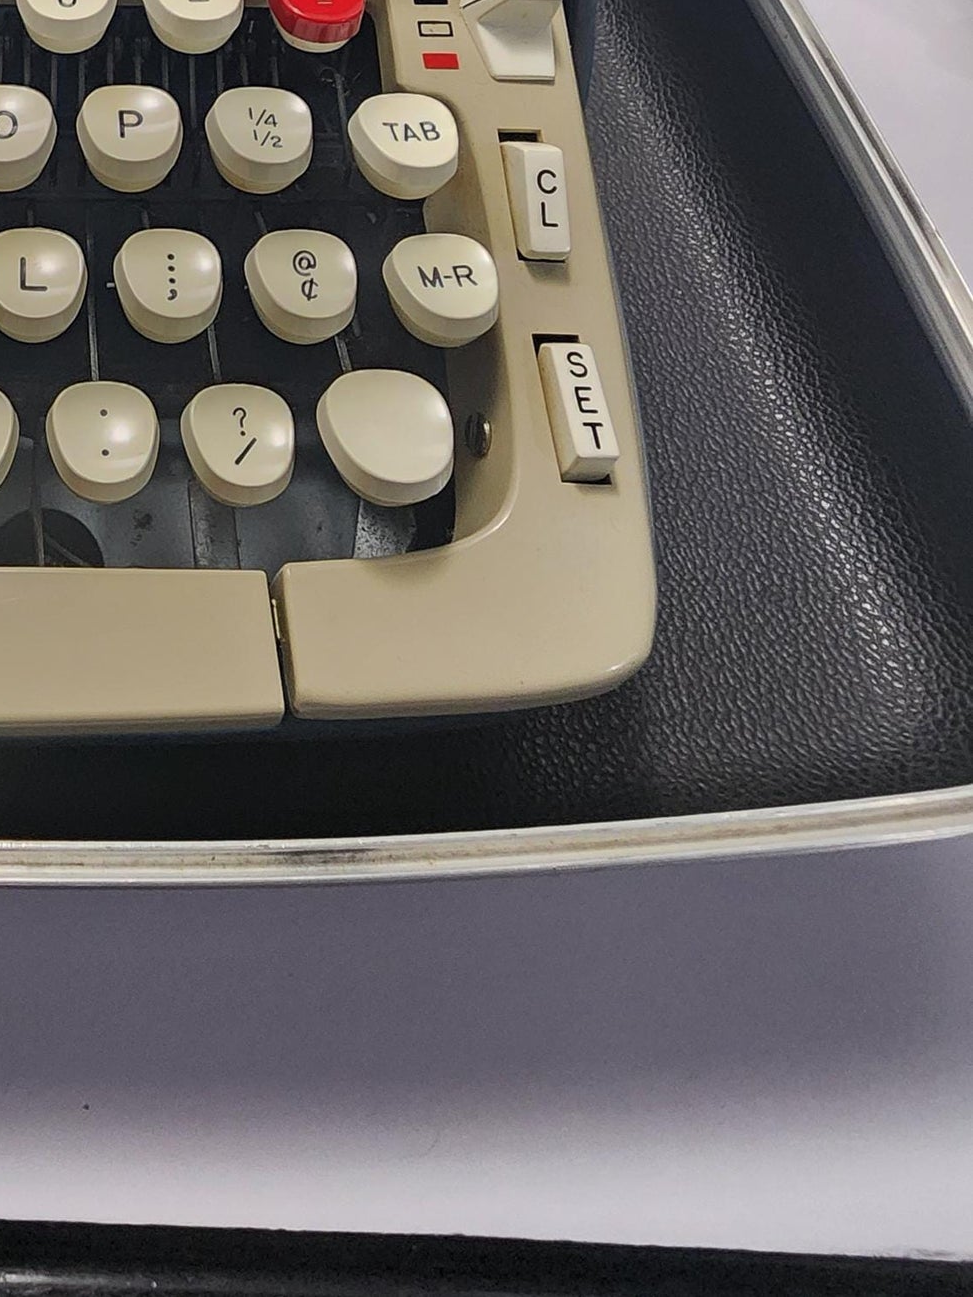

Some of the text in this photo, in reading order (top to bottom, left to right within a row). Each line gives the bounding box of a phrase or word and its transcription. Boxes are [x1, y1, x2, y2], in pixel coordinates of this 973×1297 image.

[118, 109, 144, 139] P
[382, 121, 441, 142] TAB
[536, 169, 559, 228] CL
[19, 256, 48, 292] L
[292, 249, 317, 277] @
[417, 264, 478, 288] M-R
[566, 351, 604, 450] SET
[232, 407, 247, 437] ?
